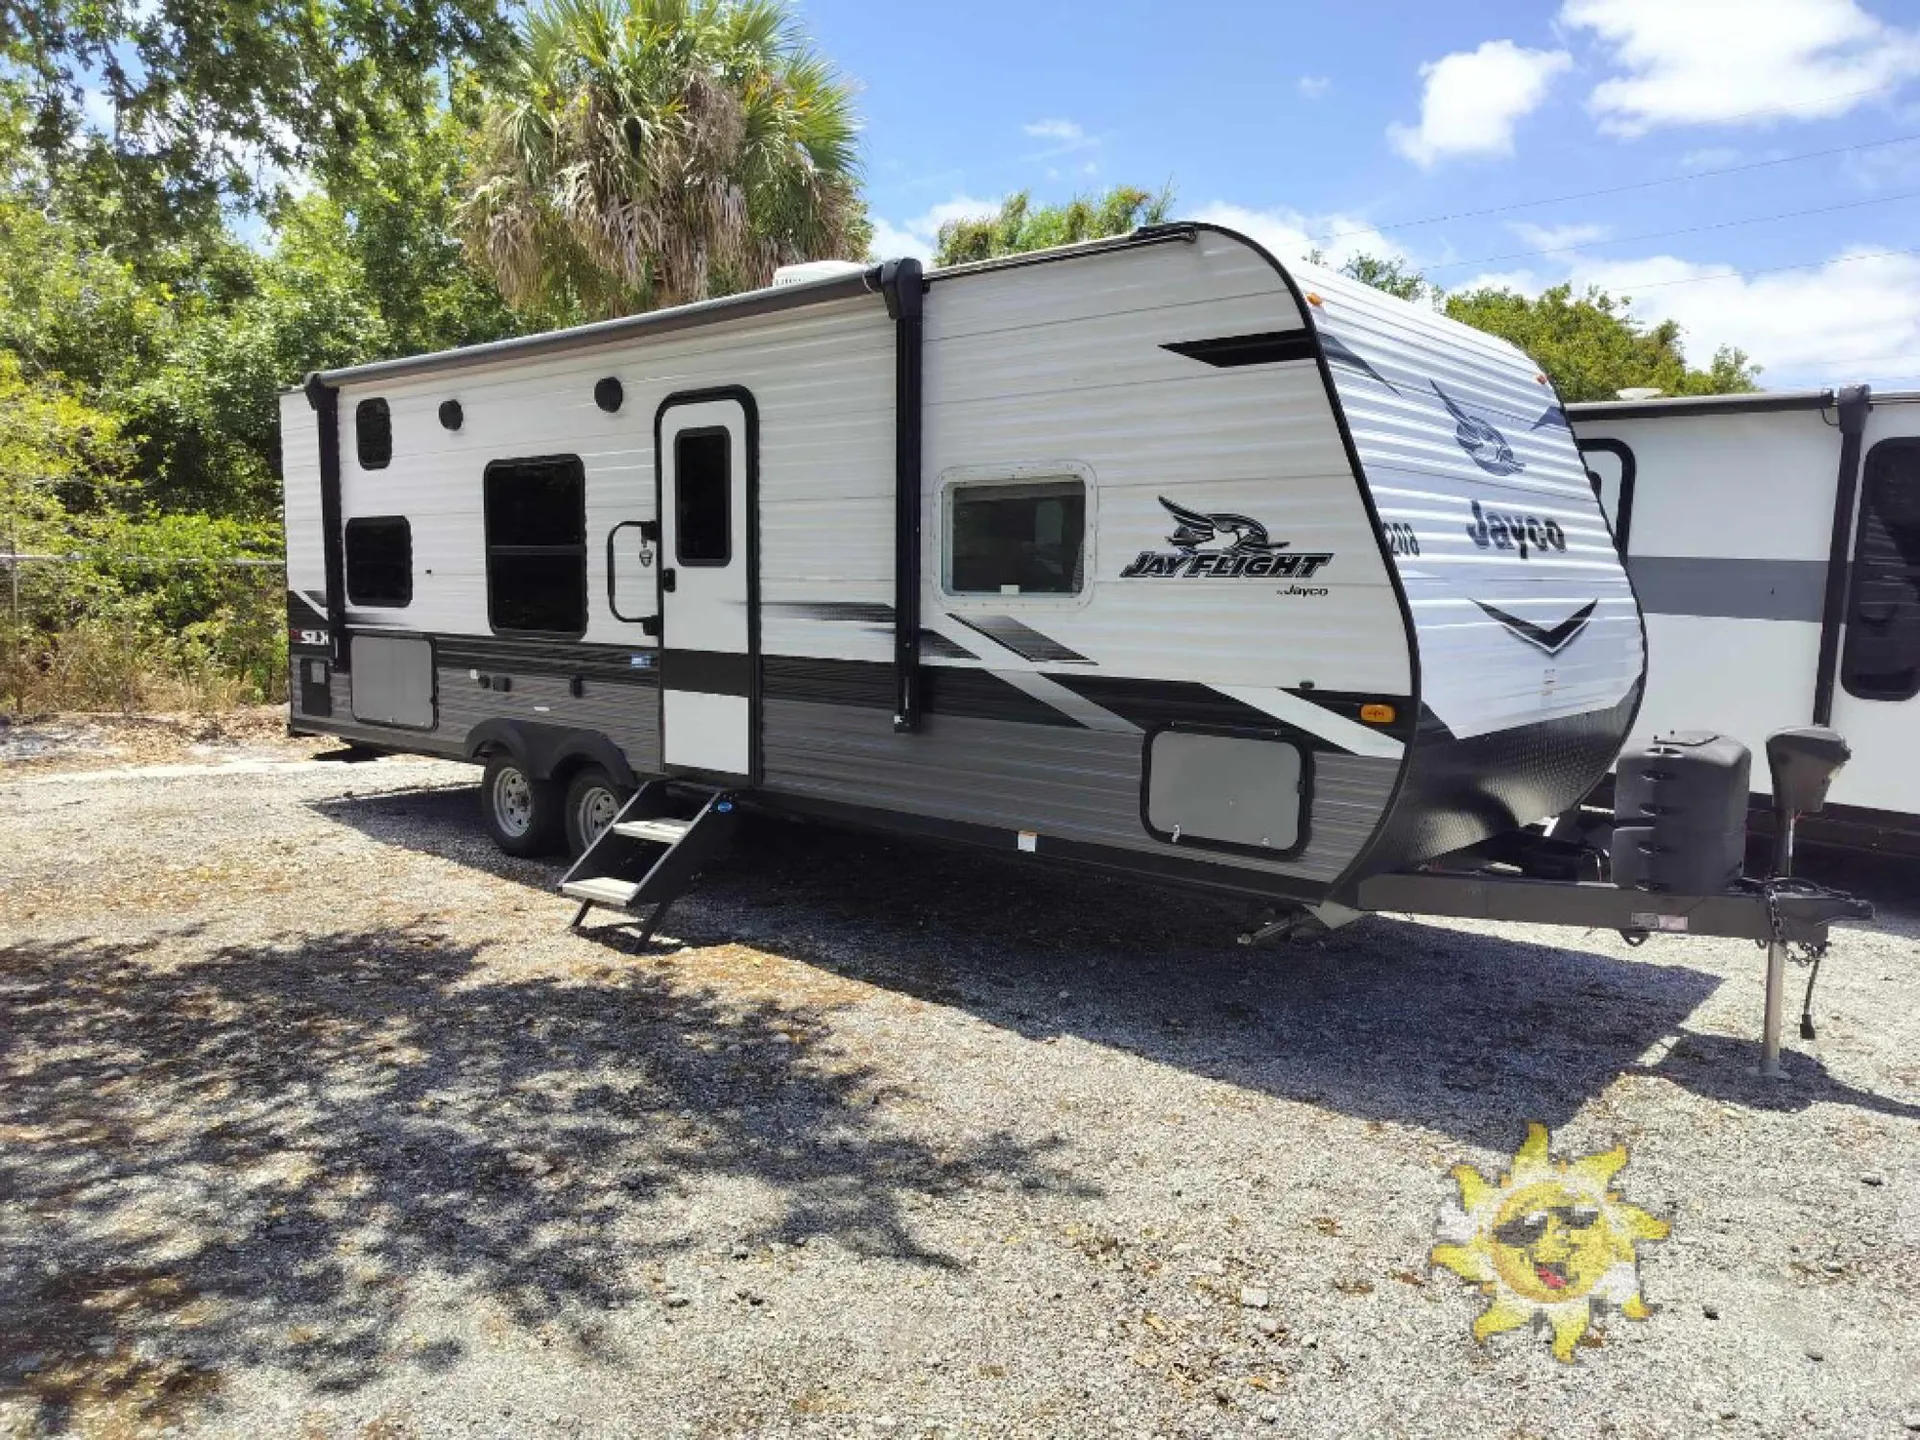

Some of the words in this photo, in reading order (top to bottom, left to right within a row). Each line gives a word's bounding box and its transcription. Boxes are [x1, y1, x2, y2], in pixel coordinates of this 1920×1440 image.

[1466, 500, 1567, 559] Jayco
[1119, 551, 1188, 578] JAY
[1182, 552, 1335, 578] FLIGHT
[1283, 584, 1329, 597] Jayco
